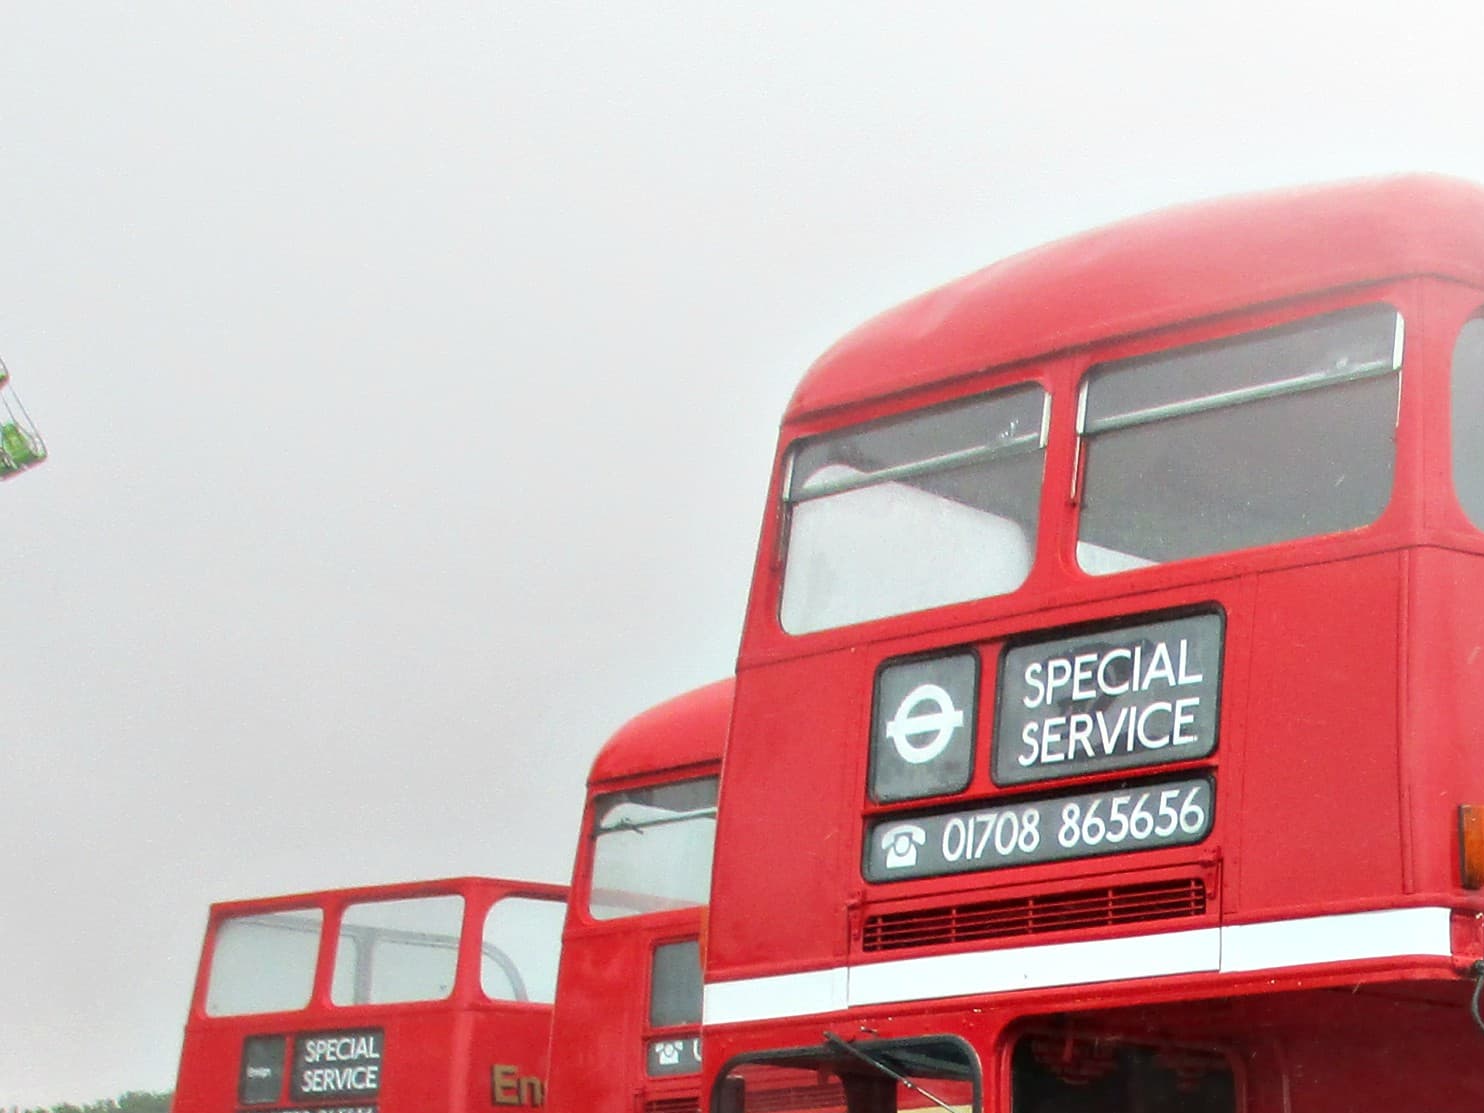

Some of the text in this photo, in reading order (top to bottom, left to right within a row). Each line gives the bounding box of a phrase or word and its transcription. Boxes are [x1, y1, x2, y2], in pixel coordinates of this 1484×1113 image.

[1022, 639, 1203, 709] SPECIAL
[1017, 697, 1201, 767] SERVICE
[941, 786, 1206, 863] 01708 865656
[304, 1036, 381, 1063] SPECIAL
[301, 1065, 380, 1093] SERVICE
[492, 1063, 544, 1107] En
